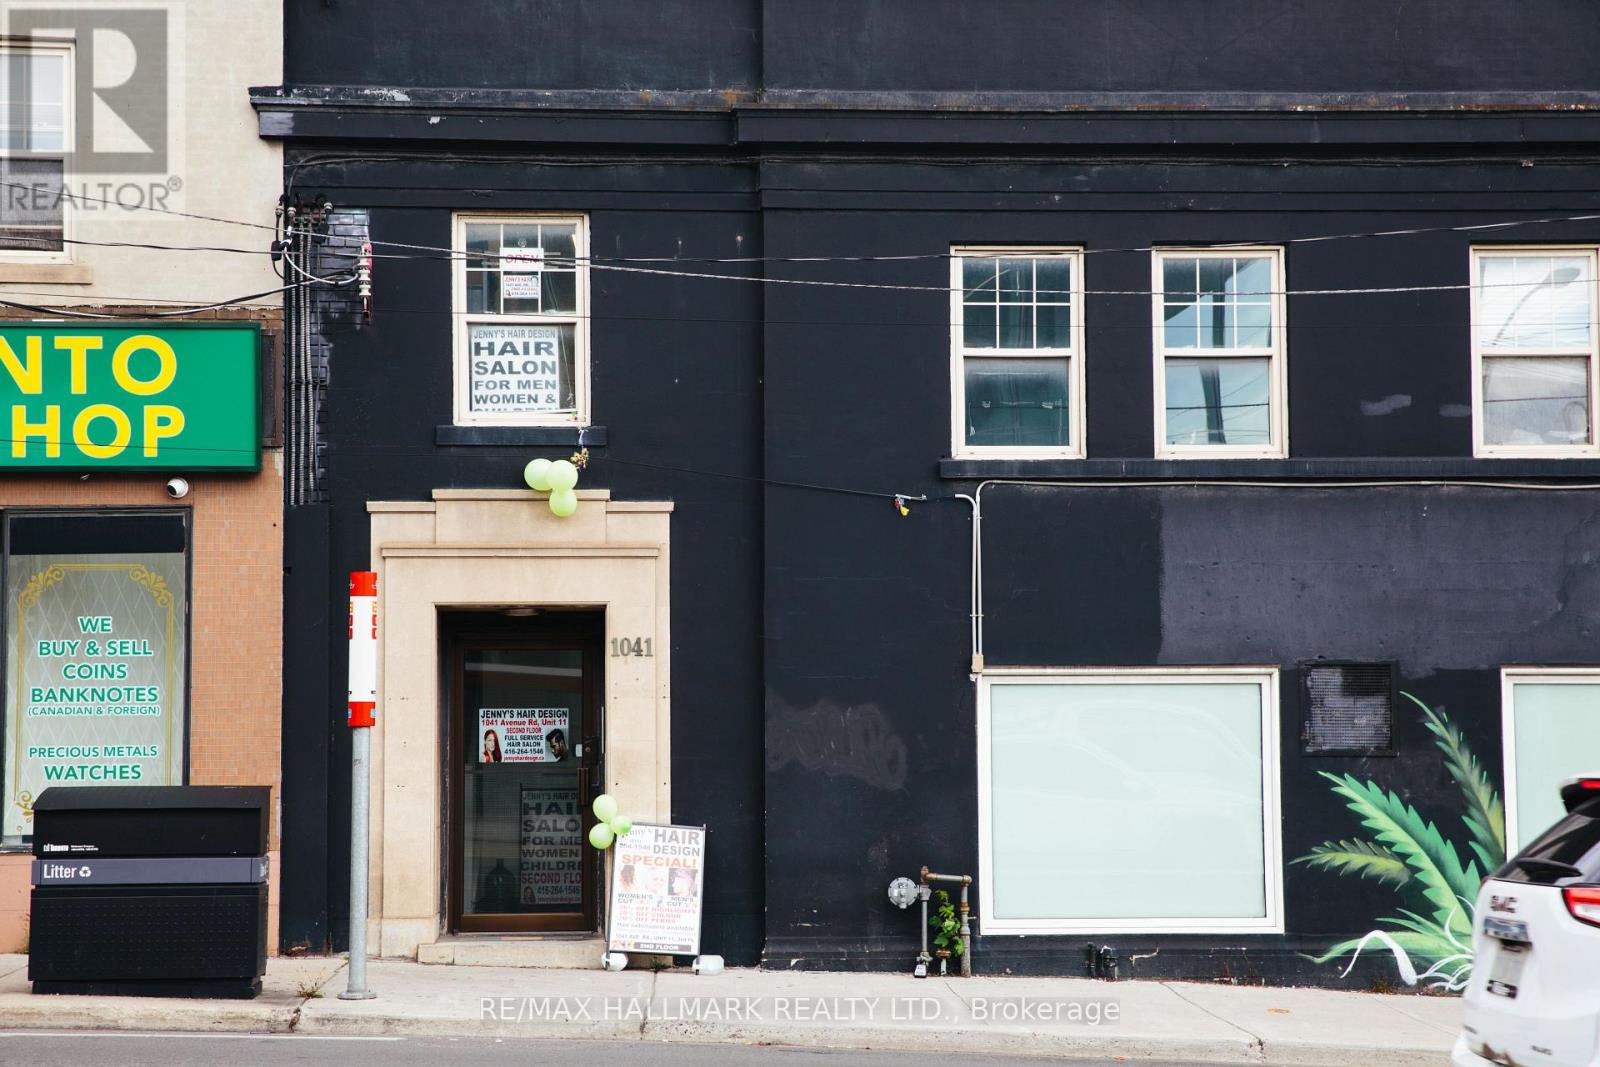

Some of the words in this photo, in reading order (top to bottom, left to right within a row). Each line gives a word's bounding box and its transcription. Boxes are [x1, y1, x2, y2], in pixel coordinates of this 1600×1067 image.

[505, 254, 539, 264] OPEN
[474, 329, 506, 339] JENNY'S
[508, 329, 527, 339] HAIR
[528, 329, 556, 339] DESIGN
[474, 341, 554, 356] HAIR
[474, 361, 556, 375] SALON
[474, 380, 511, 390] FOR
[517, 379, 557, 390] MEN
[474, 394, 538, 404] WOMEN
[545, 394, 557, 404] &
[12, 404, 185, 459] HOP
[79, 617, 112, 633] WE
[39, 641, 79, 656] BUY
[86, 640, 100, 655] &
[107, 640, 153, 656] SELL
[611, 637, 653, 657] 1041
[63, 664, 127, 679] COINS
[31, 687, 158, 703] BANKNOTES
[28, 706, 93, 717] (CANADIAN
[95, 706, 103, 715] &
[107, 706, 160, 716] FOREIGN)
[480, 709, 515, 719] JENNY'S
[517, 709, 536, 718] HAIR
[538, 709, 568, 718] DESIGN
[29, 747, 99, 758] PRECIOUS
[104, 746, 158, 757] METALS
[44, 764, 142, 780] WATCHES
[523, 802, 582, 816] HAI
[522, 836, 555, 846] FOR
[654, 829, 700, 845] HAIR
[521, 848, 579, 858] WOMEN
[653, 844, 700, 857] DESIGN
[621, 854, 697, 869] SPECIAL!
[44, 863, 77, 879] Litter
[521, 872, 561, 884] SECOND
[617, 893, 653, 901] WOMEN'S
